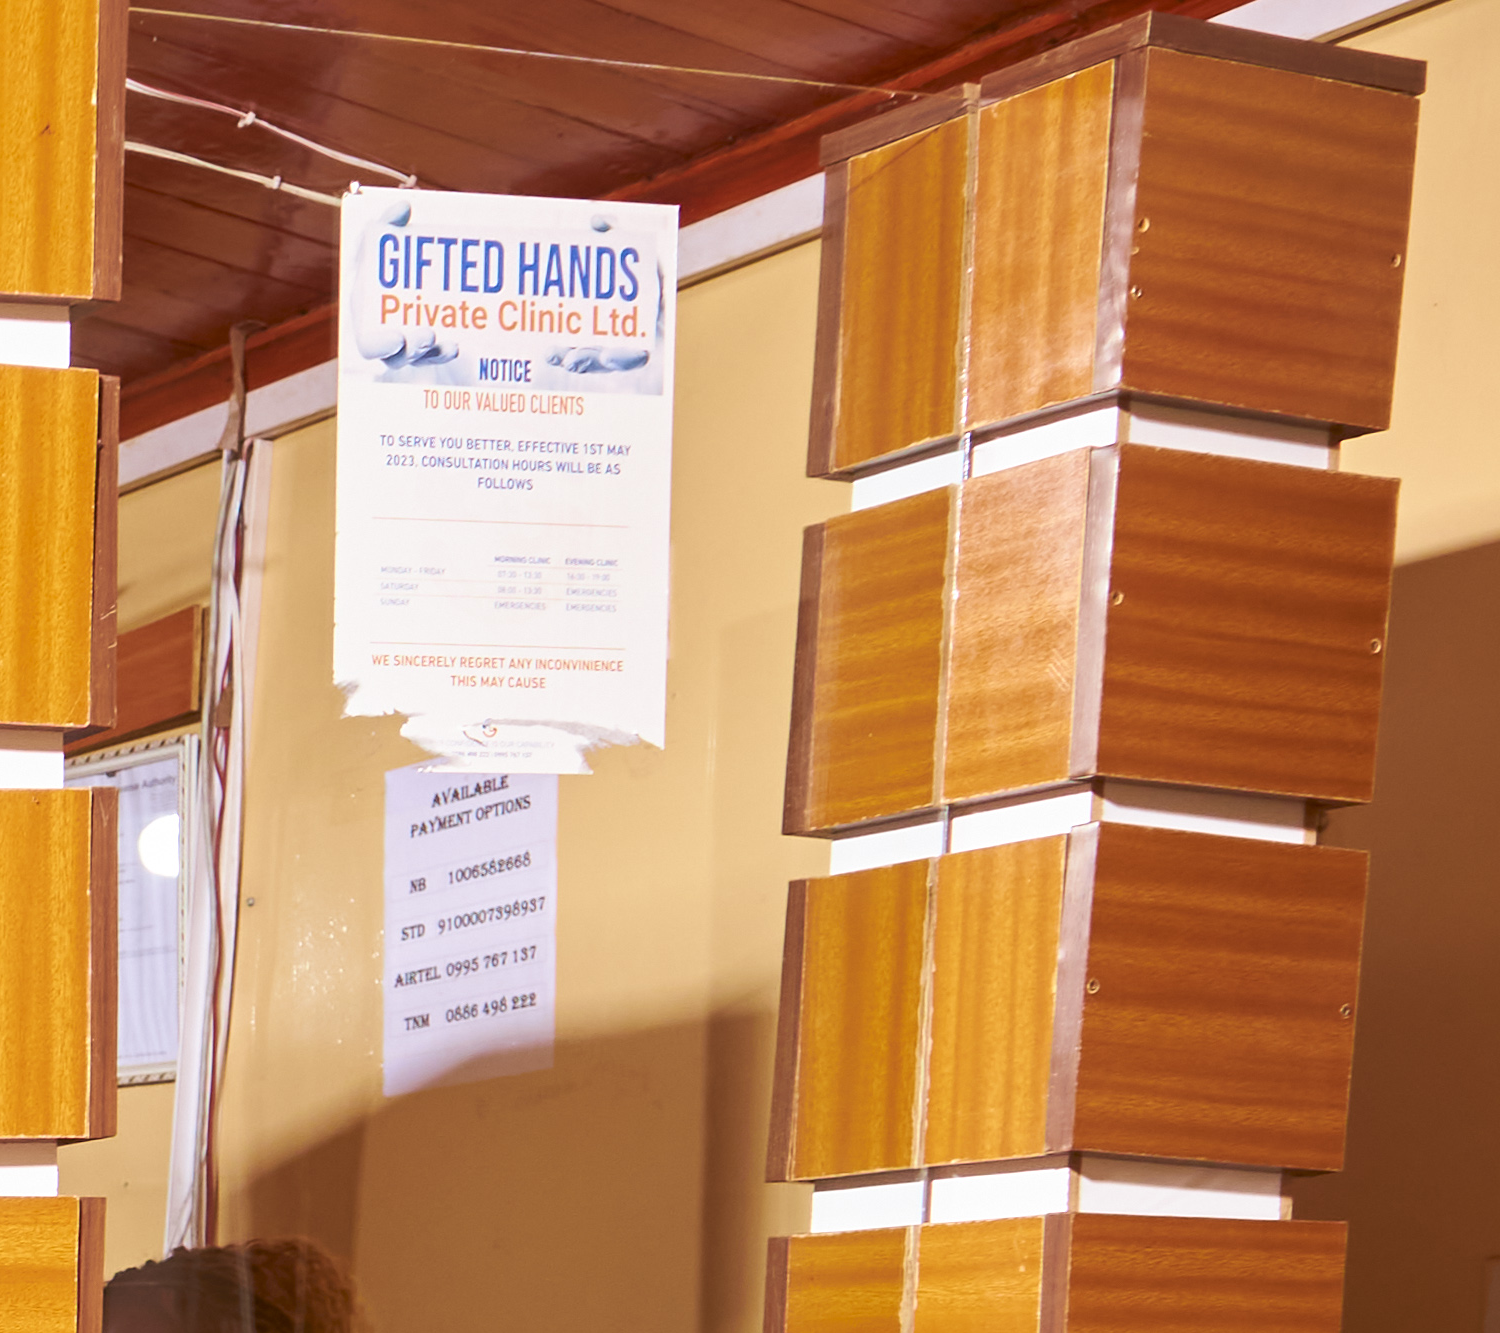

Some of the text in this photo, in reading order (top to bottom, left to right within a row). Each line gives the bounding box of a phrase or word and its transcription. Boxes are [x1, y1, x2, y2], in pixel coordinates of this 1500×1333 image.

[378, 233, 639, 302] GIFTED HANDS
[380, 294, 646, 337] Private Clinic Ltd.
[479, 358, 532, 382] NOTICE
[424, 389, 584, 415] TO OUR VALUED CLIENTS
[380, 434, 395, 446] TO
[398, 435, 436, 448] SERVE
[440, 437, 463, 450] YOU
[518, 440, 579, 454] EFFECTIVE
[583, 443, 602, 455] 1ST
[607, 444, 631, 456] MAY
[421, 455, 508, 471] CONSULTATION
[512, 459, 552, 472] HOURS
[556, 460, 583, 473] WILL
[587, 461, 601, 474] BE
[605, 463, 621, 475] AS
[477, 477, 533, 491] FOLLOWS
[372, 654, 624, 672] WE SINCERELY REGRET ANY INCONVINIENCE
[450, 675, 546, 689] THIS MAY CAUSE
[431, 775, 510, 808] AVAILABLE
[411, 794, 531, 839] PAYMENT OPTIONS
[409, 877, 427, 894] NB
[401, 923, 425, 941] STD
[394, 966, 441, 988] AIRTEL
[446, 957, 479, 978] 0995
[484, 951, 508, 969] 767
[483, 996, 508, 1017] 498
